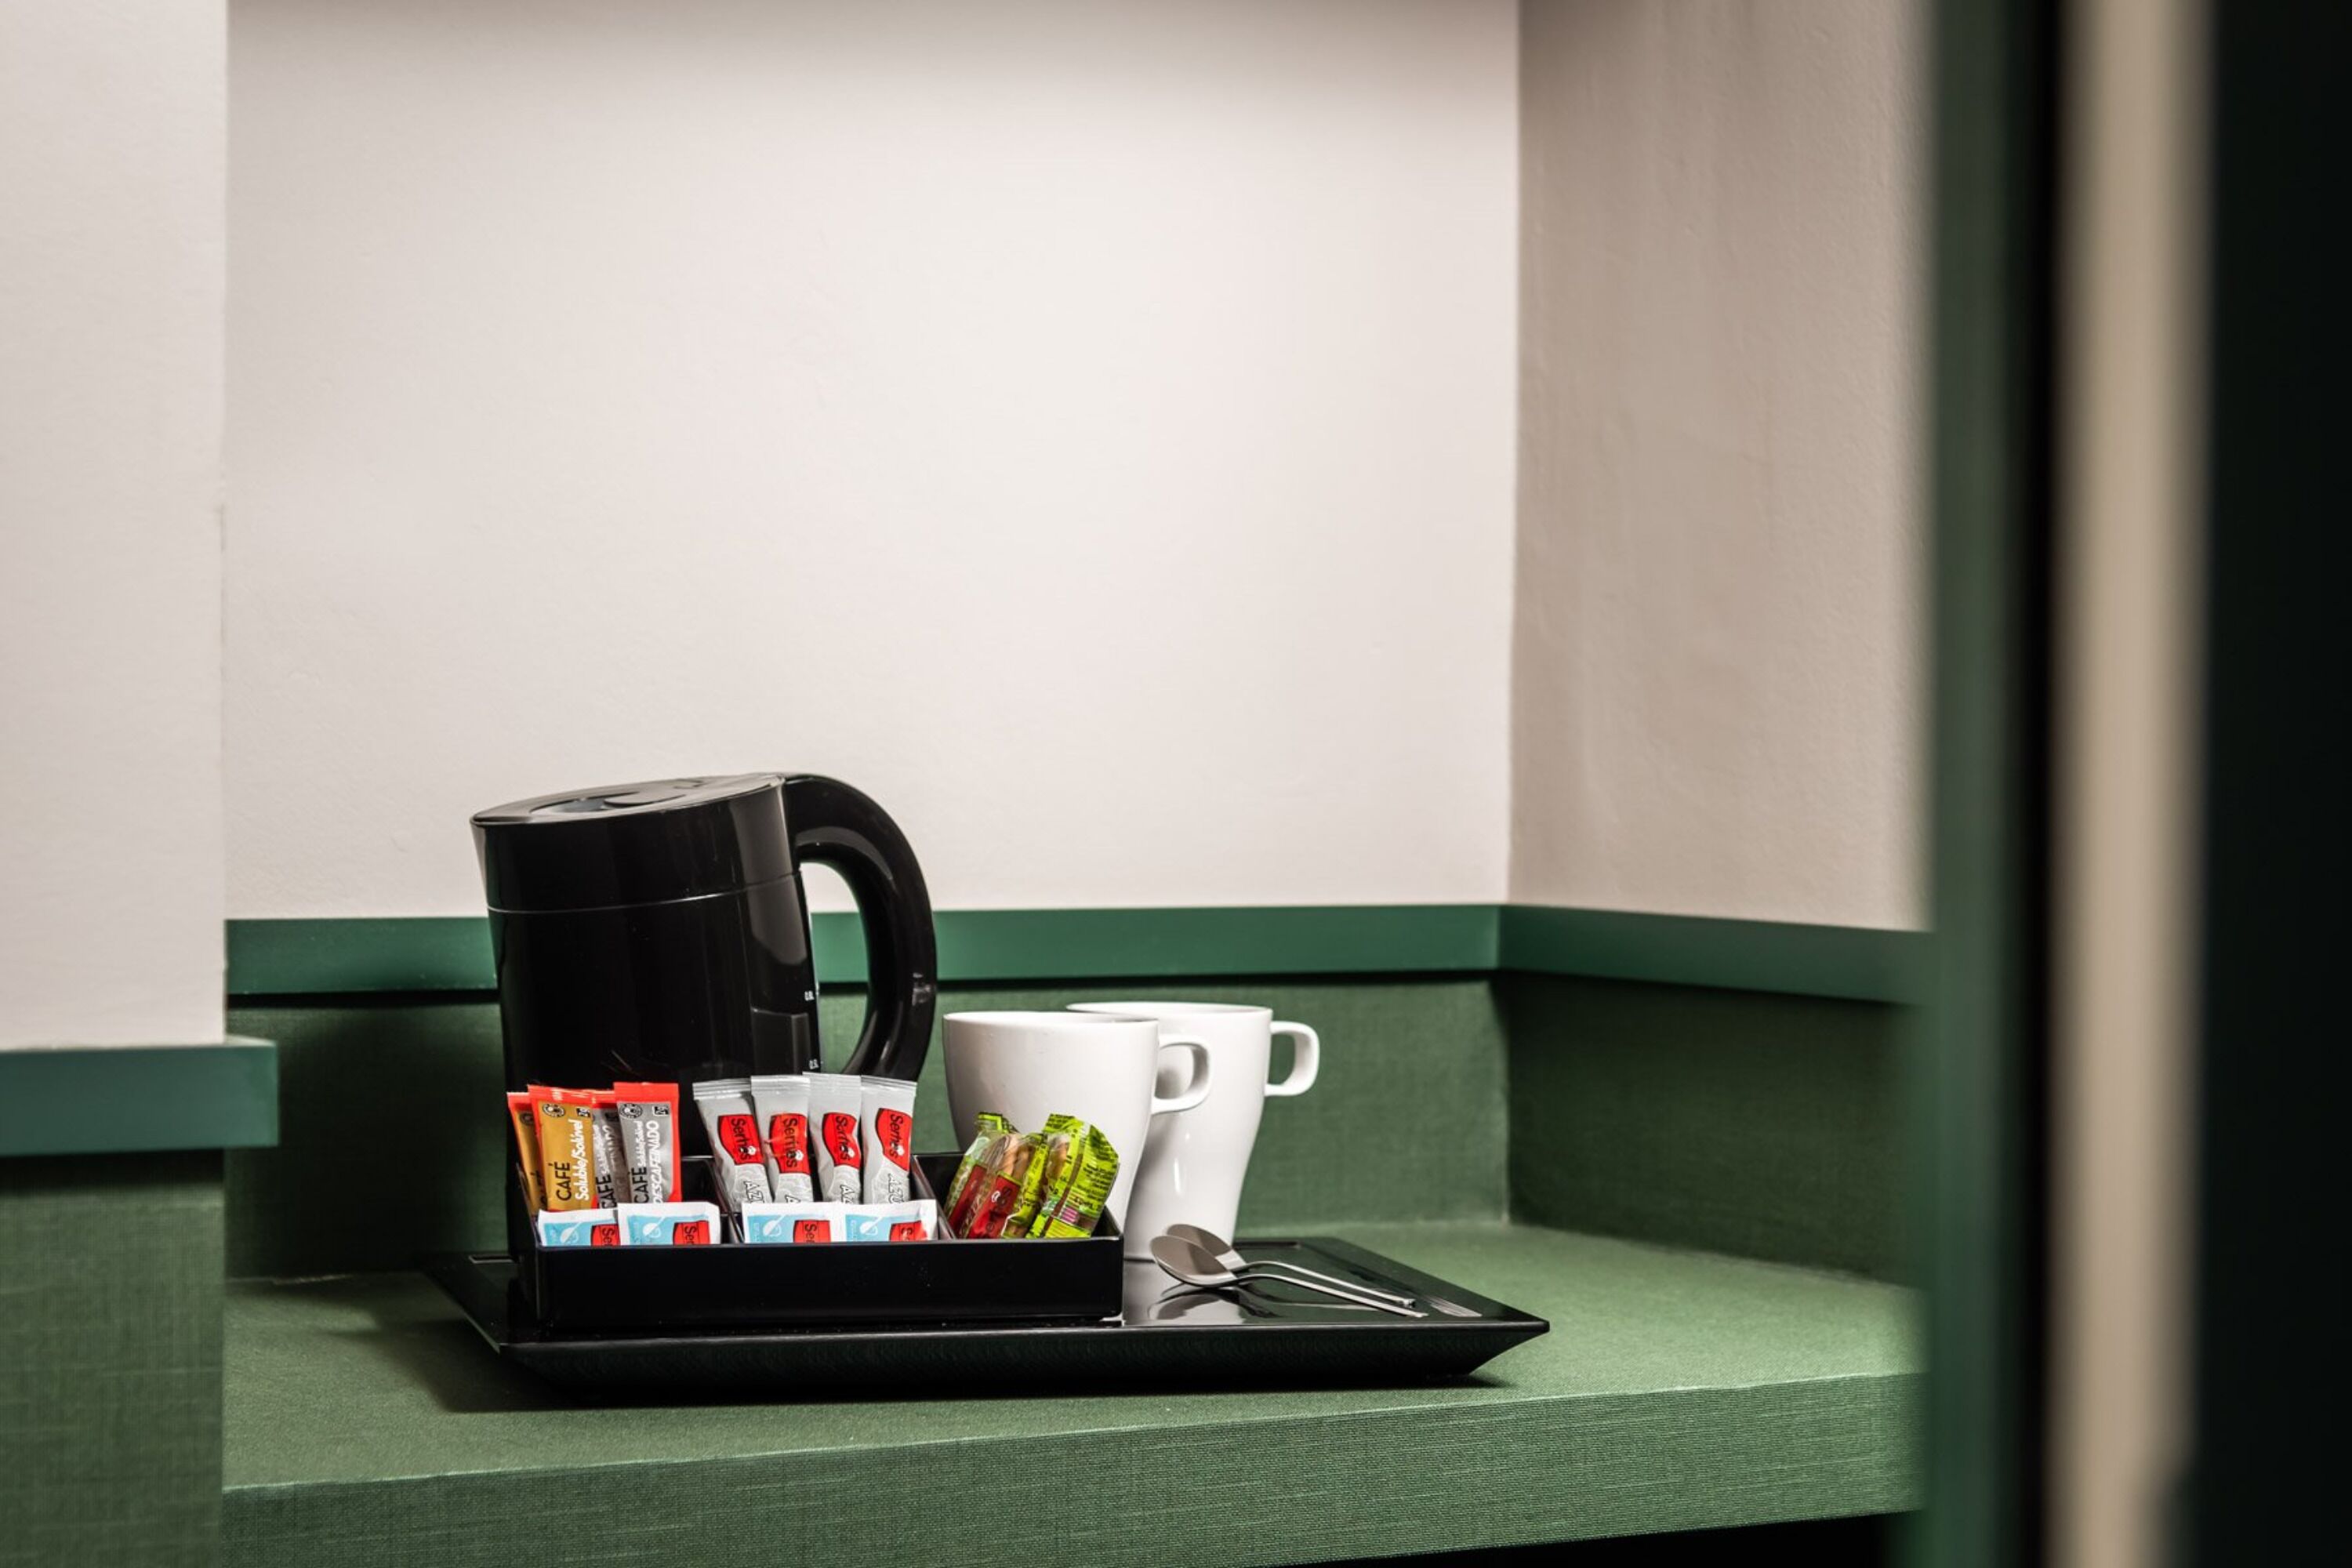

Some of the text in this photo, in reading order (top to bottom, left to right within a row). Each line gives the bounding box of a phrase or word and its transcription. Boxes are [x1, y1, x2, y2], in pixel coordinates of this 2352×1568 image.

[568, 1119, 590, 1201] Soluble/Solúvel
[549, 1161, 572, 1201] CAFÉ
[627, 1166, 650, 1203] CAFÉ
